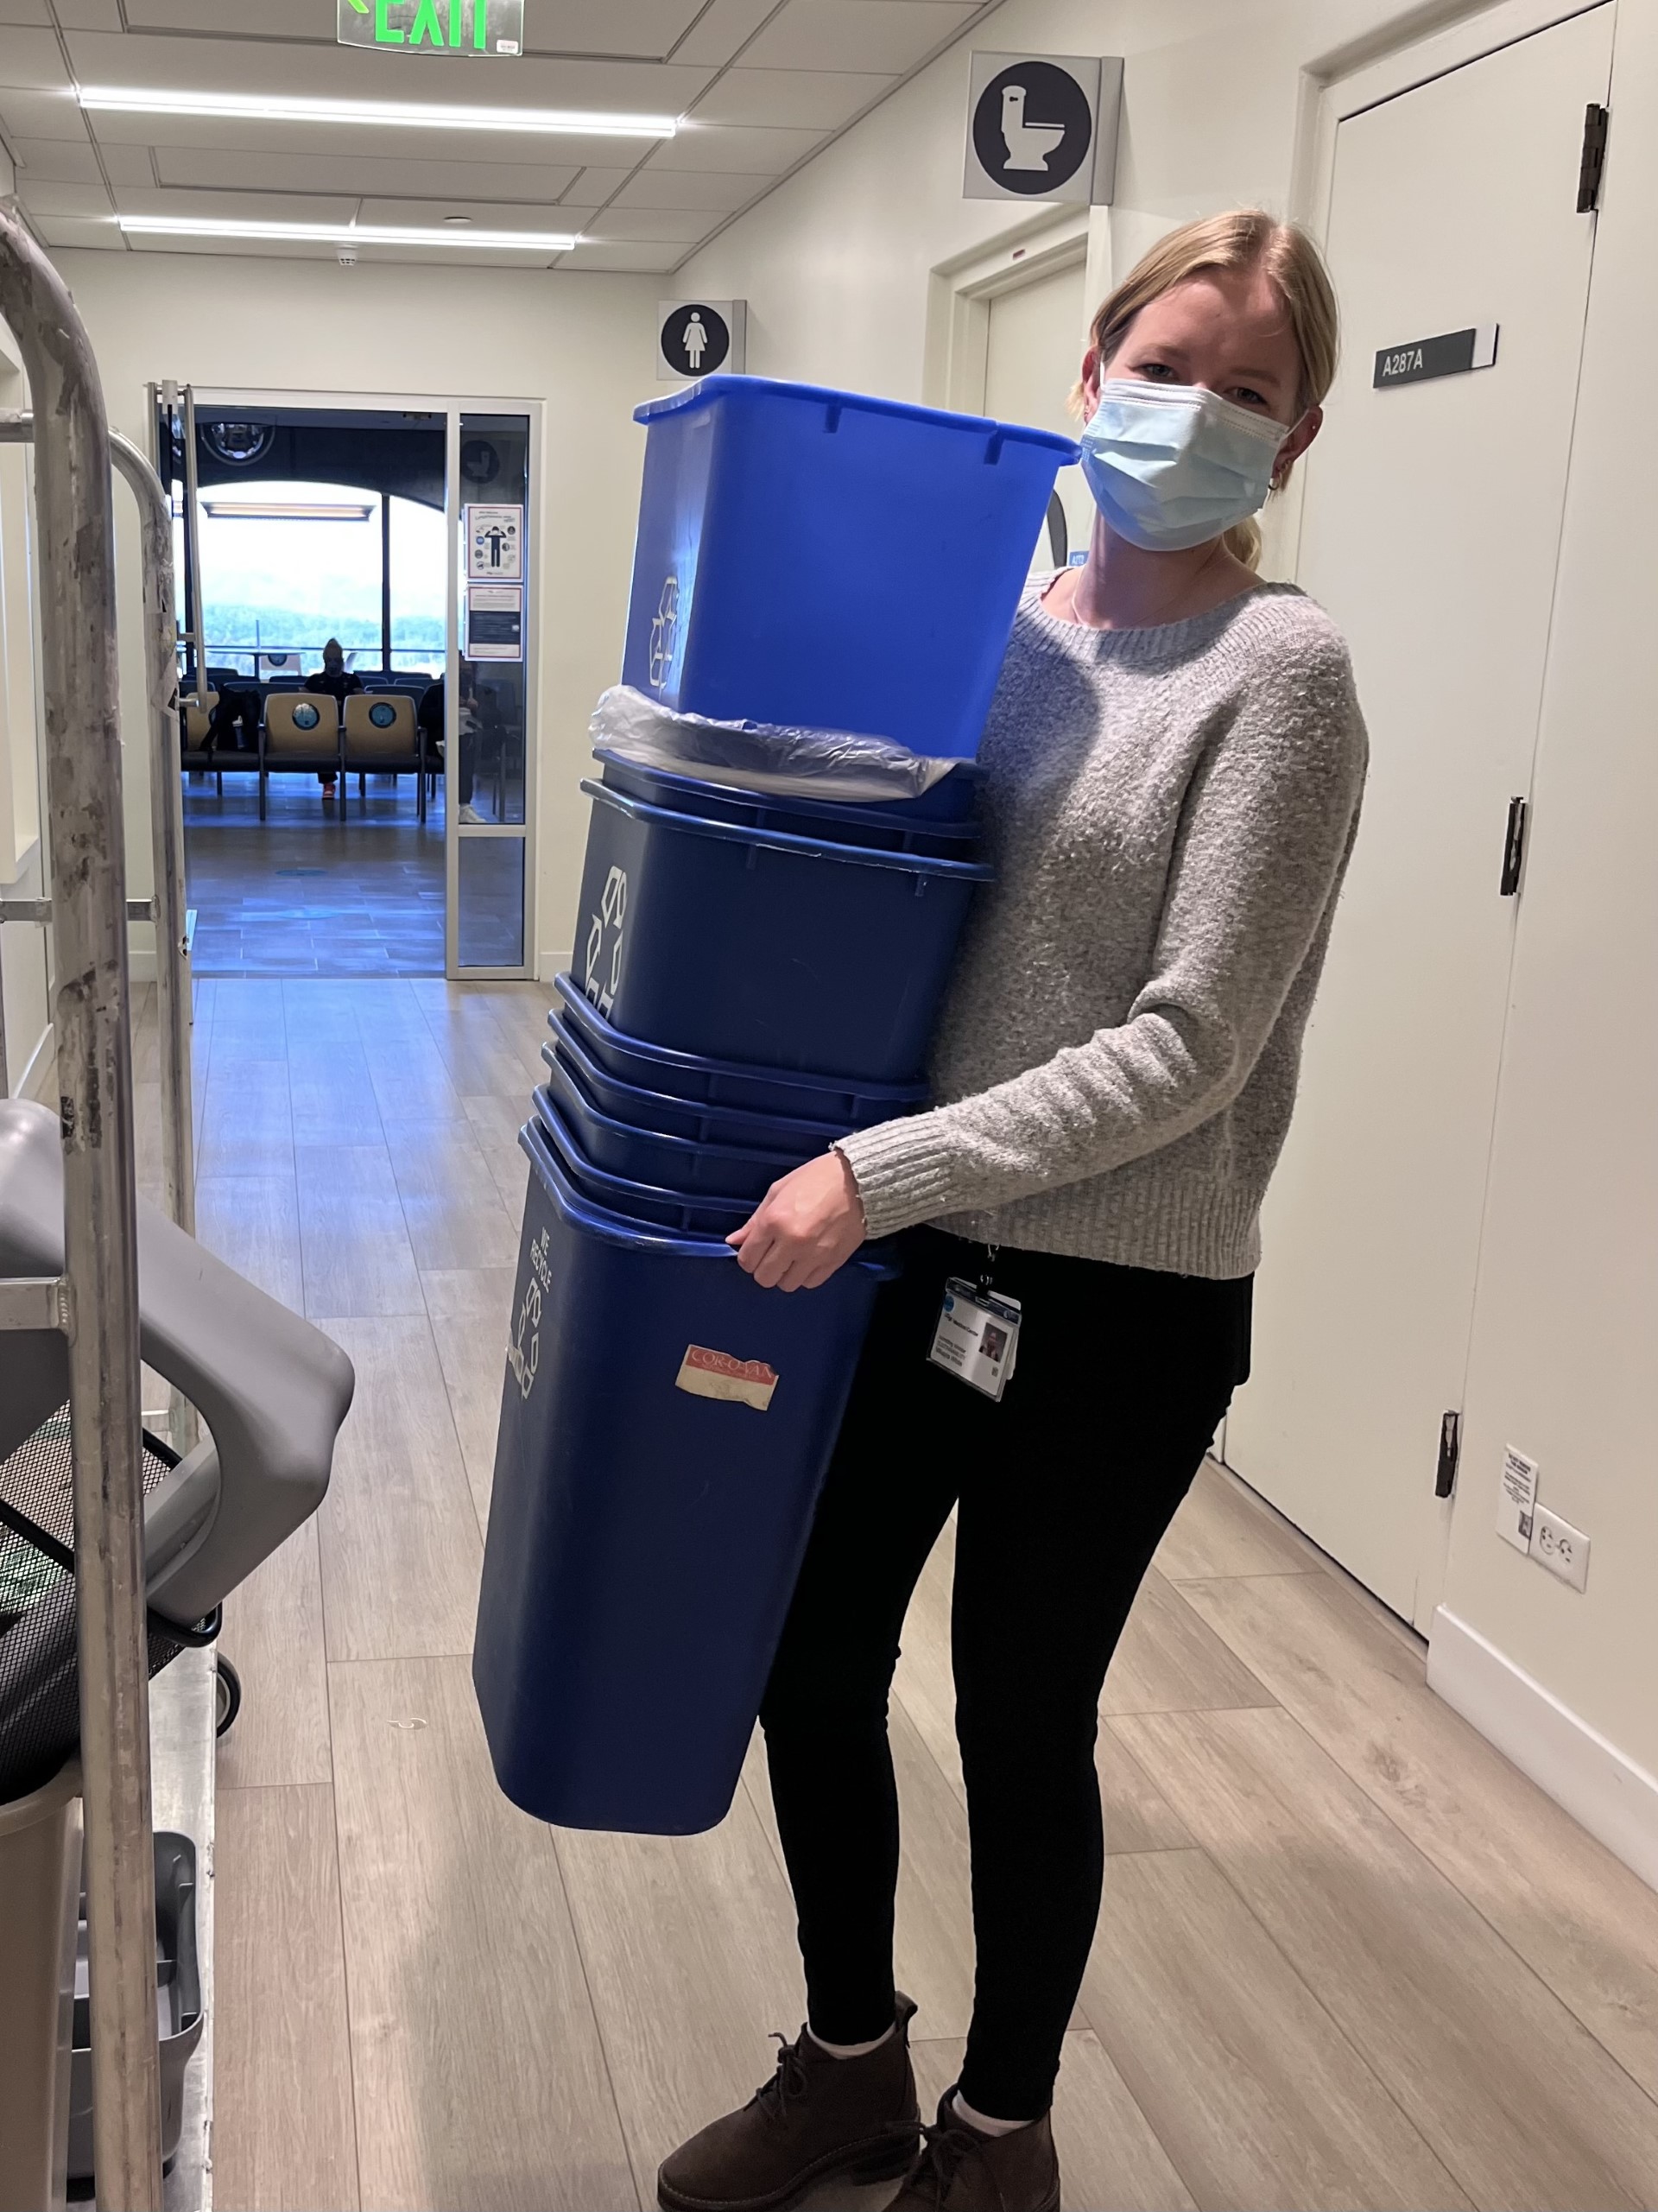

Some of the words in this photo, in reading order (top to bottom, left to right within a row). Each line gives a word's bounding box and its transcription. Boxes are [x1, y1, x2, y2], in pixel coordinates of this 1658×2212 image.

[1383, 348, 1423, 377] A287A
[540, 1226, 550, 1257] WE
[529, 1238, 552, 1294] RECYCLE
